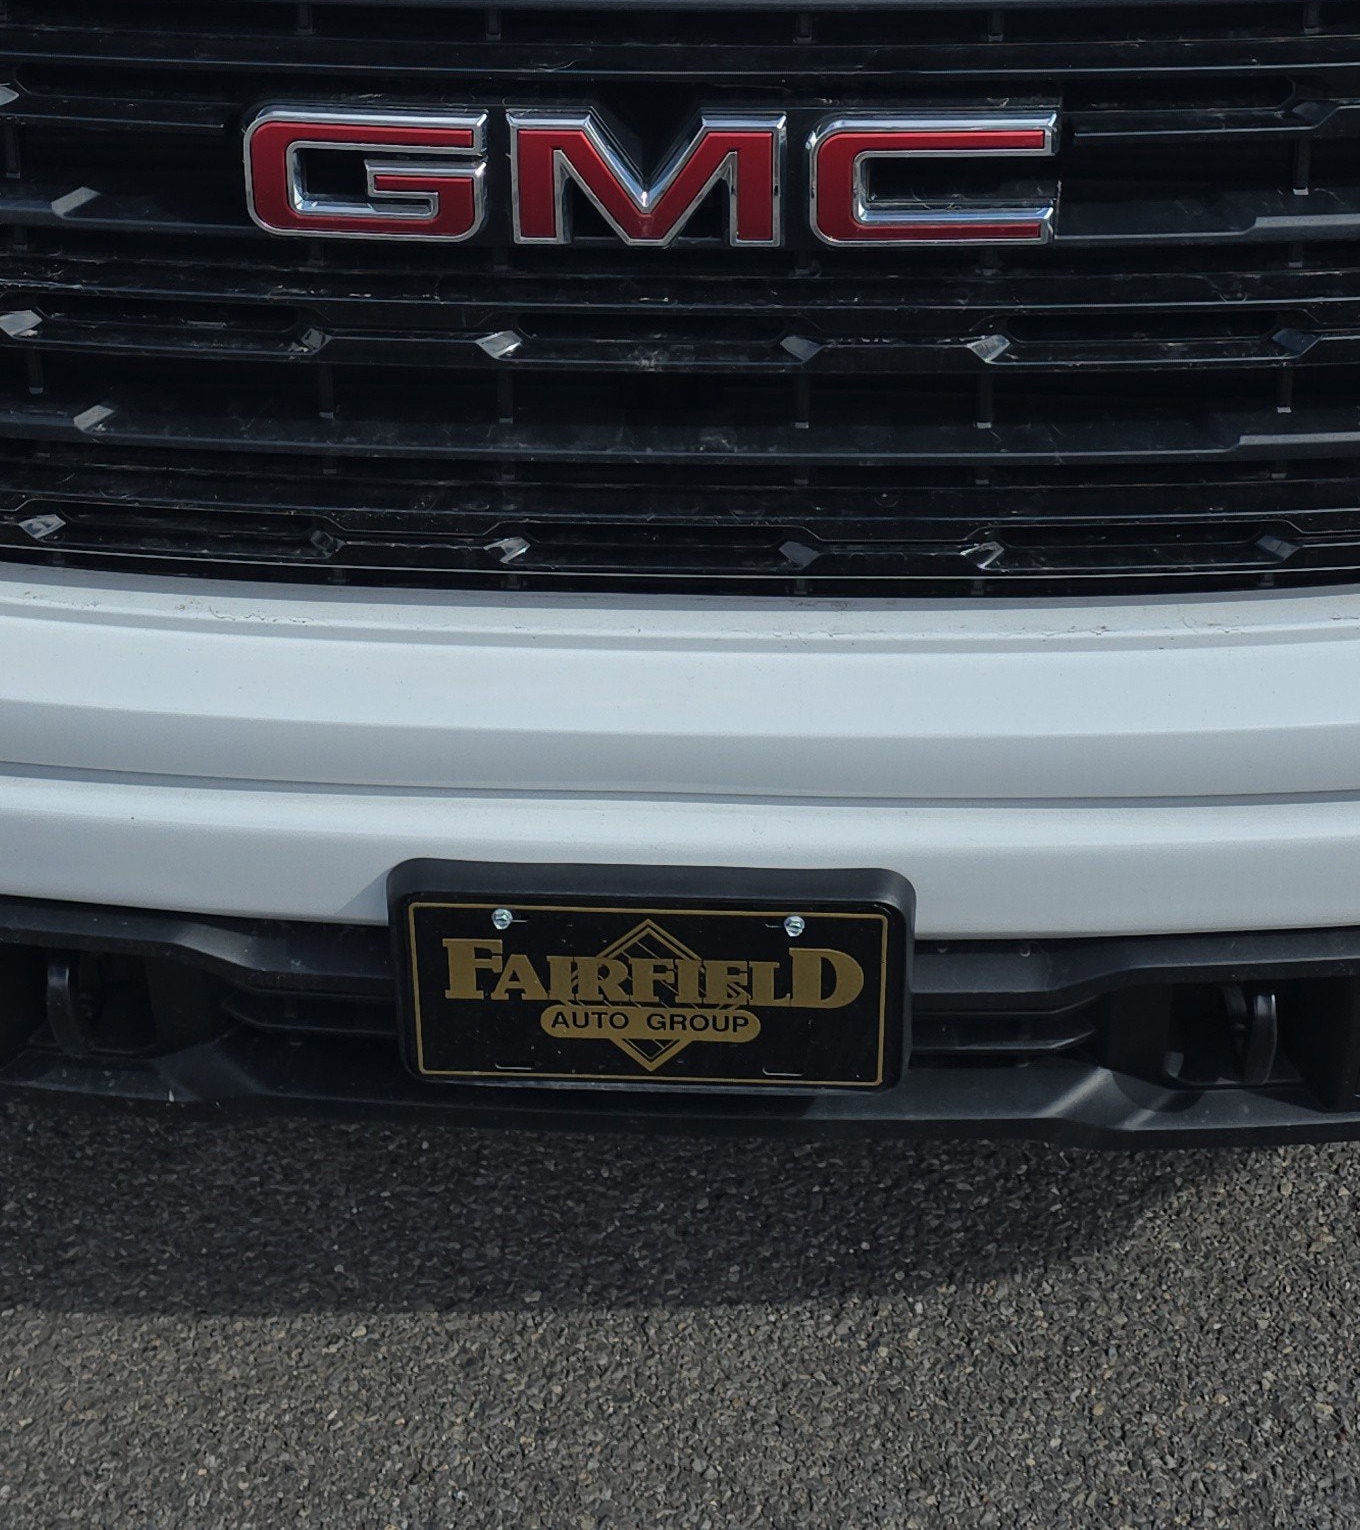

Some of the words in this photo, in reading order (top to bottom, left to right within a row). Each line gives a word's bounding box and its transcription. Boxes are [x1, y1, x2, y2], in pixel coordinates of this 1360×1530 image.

[243, 109, 1060, 247] GMC
[442, 937, 865, 1009] FAIRFIELD
[551, 1010, 630, 1031] AUTO
[645, 1013, 749, 1034] GROUP
